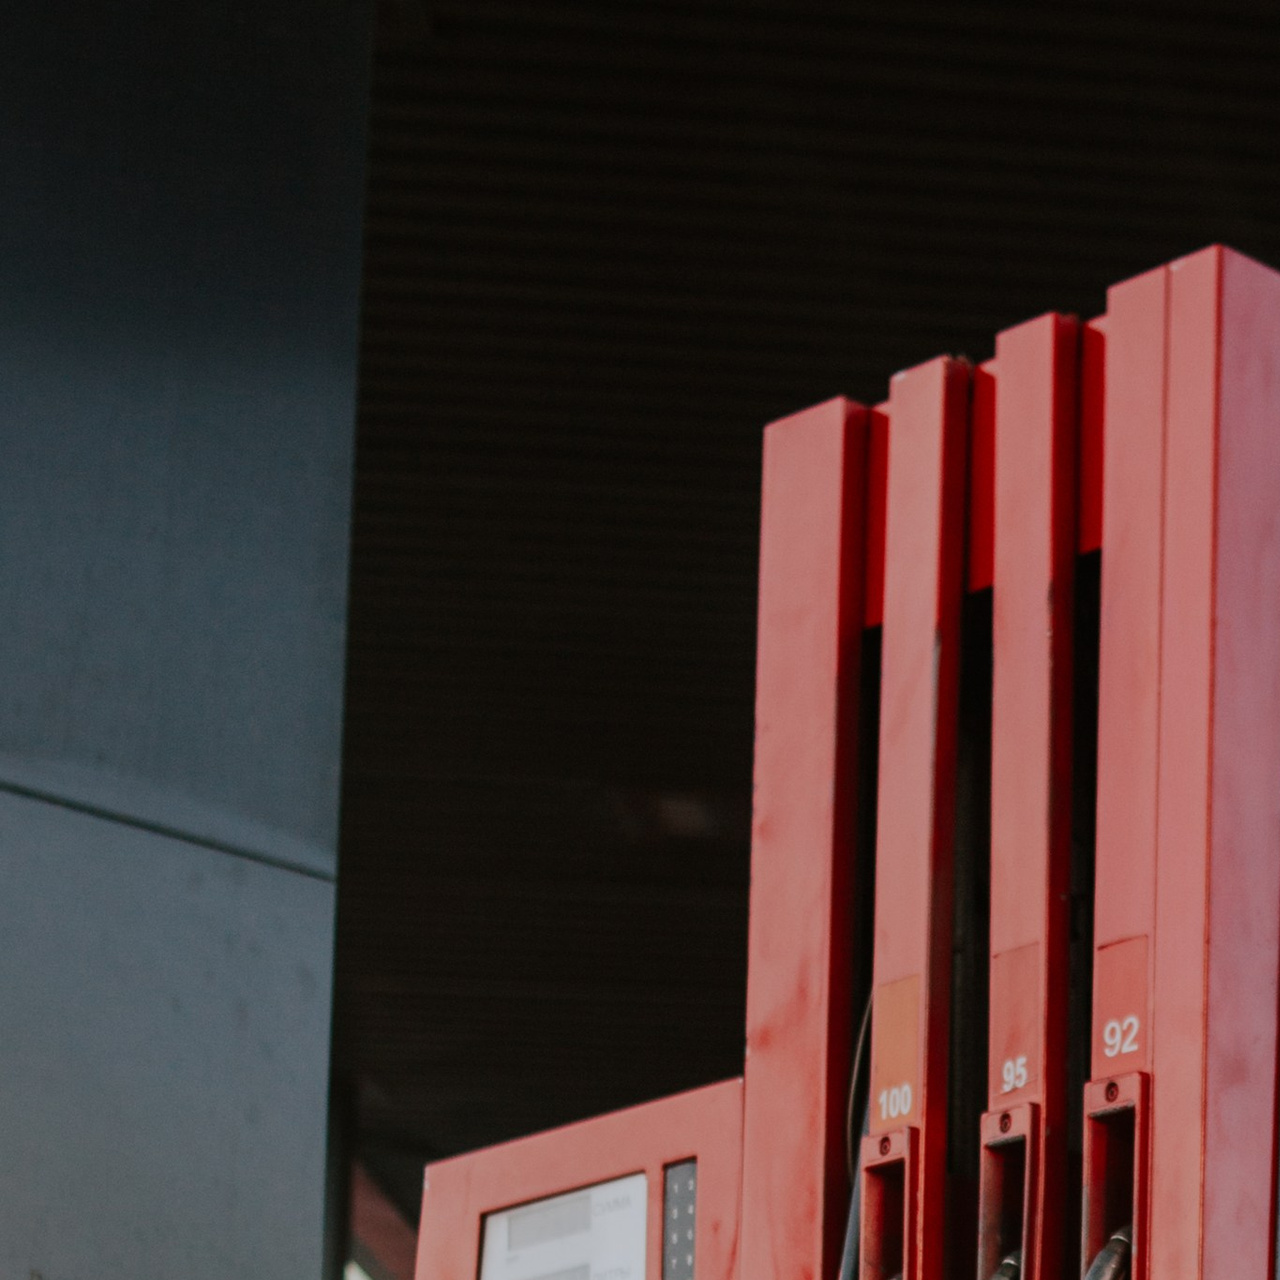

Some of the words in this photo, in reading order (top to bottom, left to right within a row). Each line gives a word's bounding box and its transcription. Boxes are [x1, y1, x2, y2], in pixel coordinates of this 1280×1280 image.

[1103, 1015, 1139, 1057] 92
[1002, 1055, 1028, 1093] 95
[879, 1084, 912, 1119] 100
